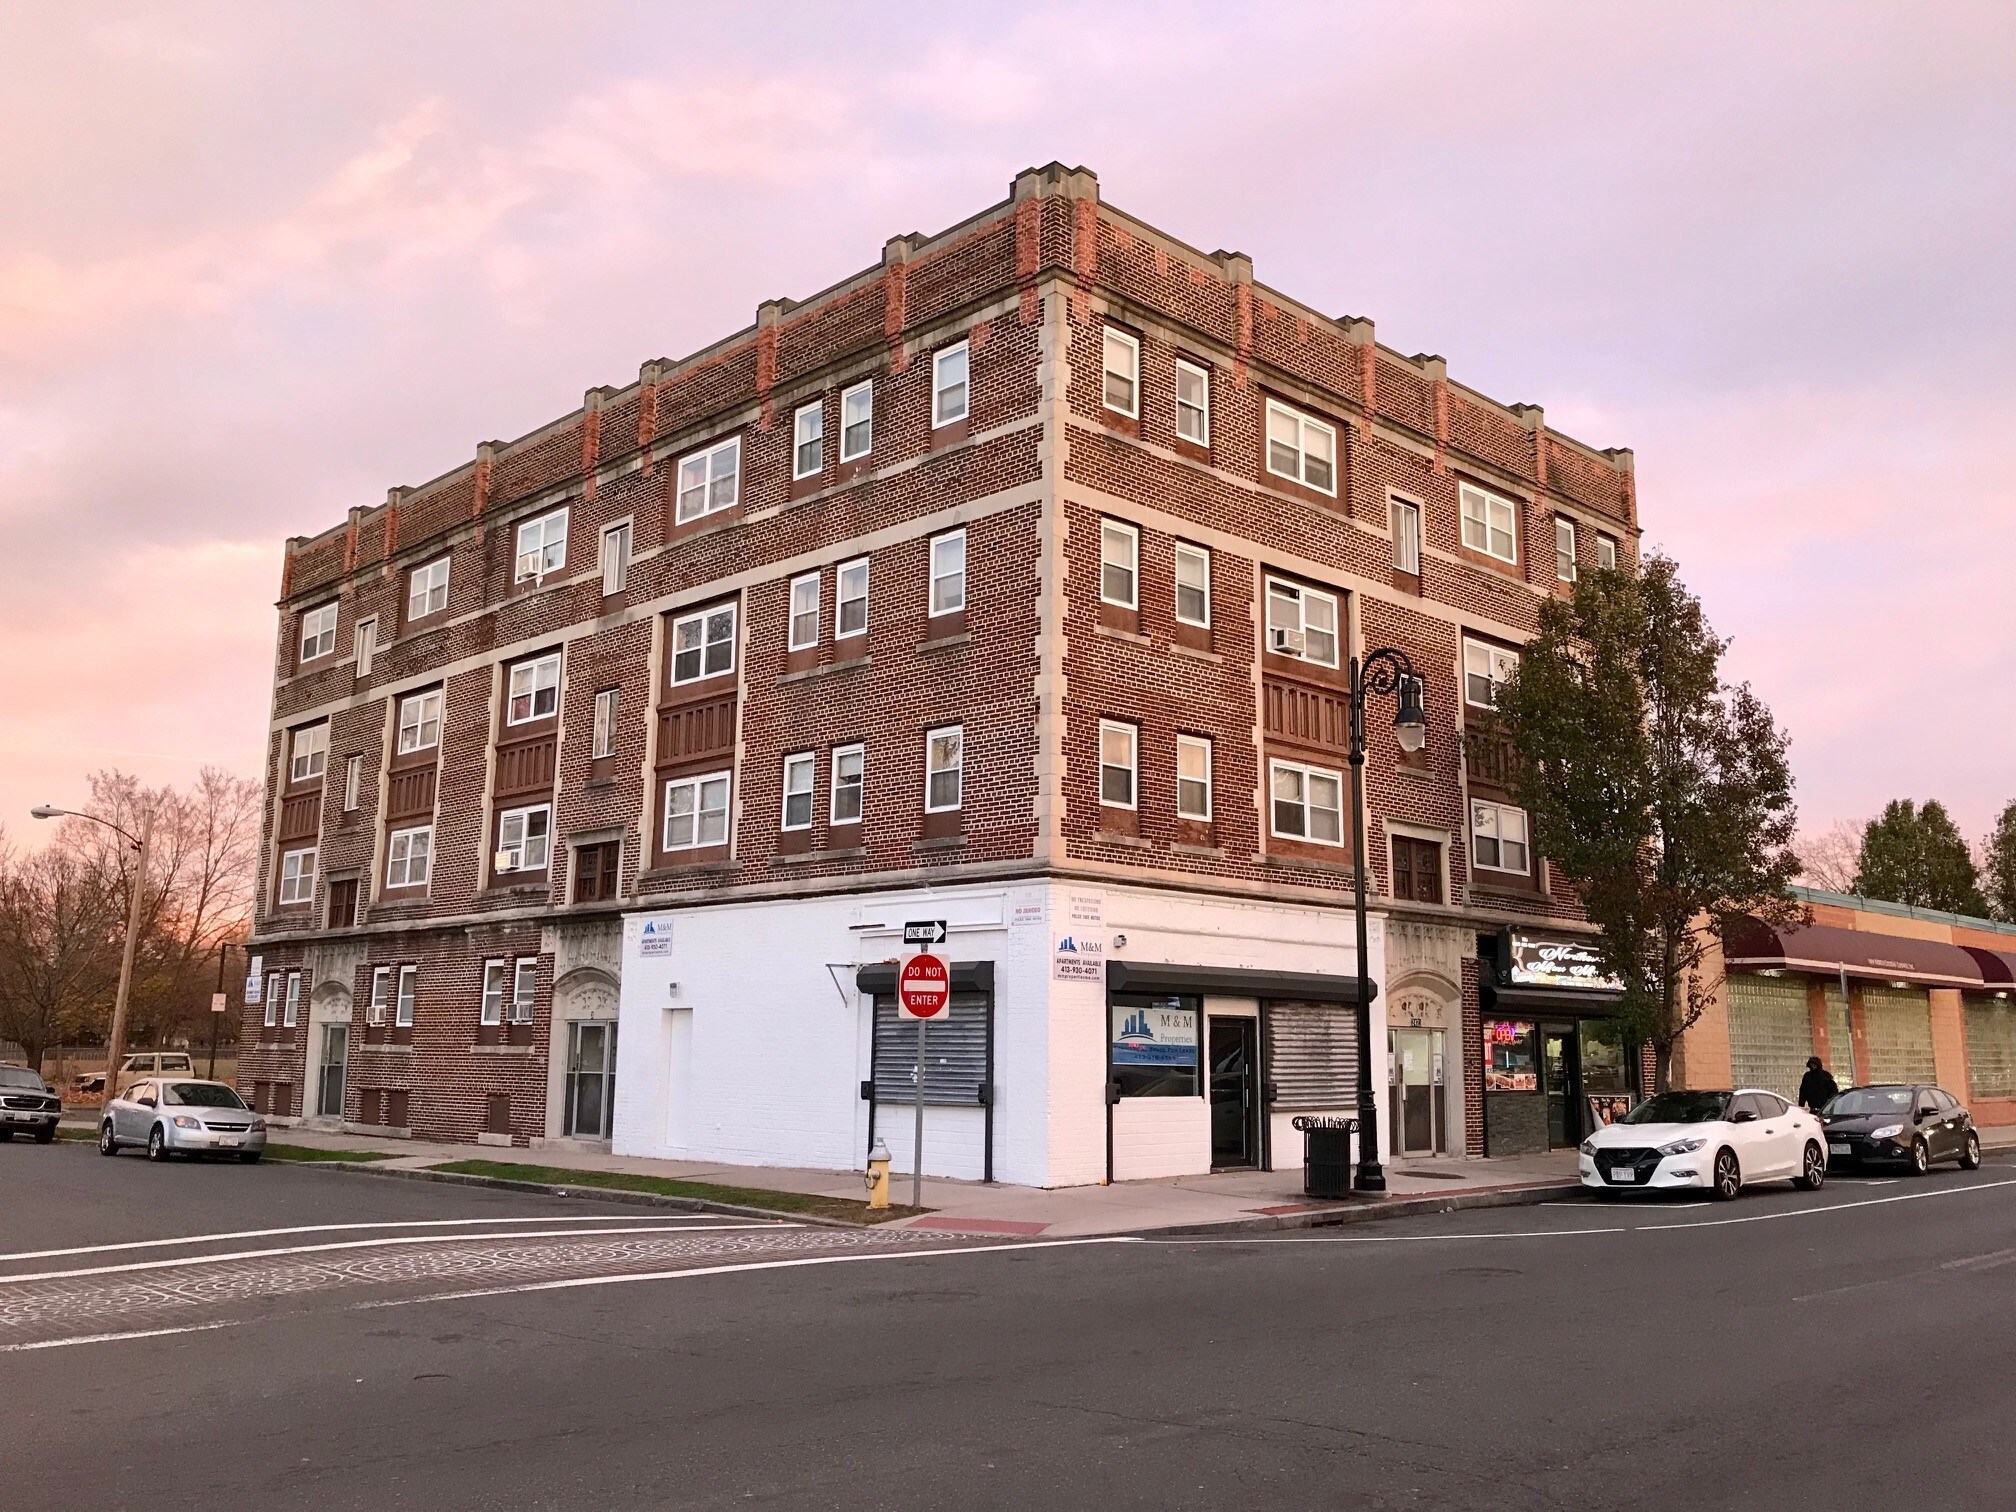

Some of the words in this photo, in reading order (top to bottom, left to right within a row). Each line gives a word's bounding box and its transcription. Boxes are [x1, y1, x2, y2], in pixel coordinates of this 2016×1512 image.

[908, 928, 920, 937] ONE
[922, 928, 934, 937] WAY
[1080, 941, 1102, 952] M&M
[908, 967, 920, 976] DO
[925, 967, 942, 977] NOT
[1061, 966, 1098, 974] 413-930-4071
[910, 995, 938, 1005] ENTER
[1161, 1015, 1170, 1026] M
[1173, 1016, 1180, 1028] &
[1183, 1016, 1192, 1028] M
[1160, 1033, 1193, 1045] Properties
[1496, 1027, 1515, 1041] OPEN
